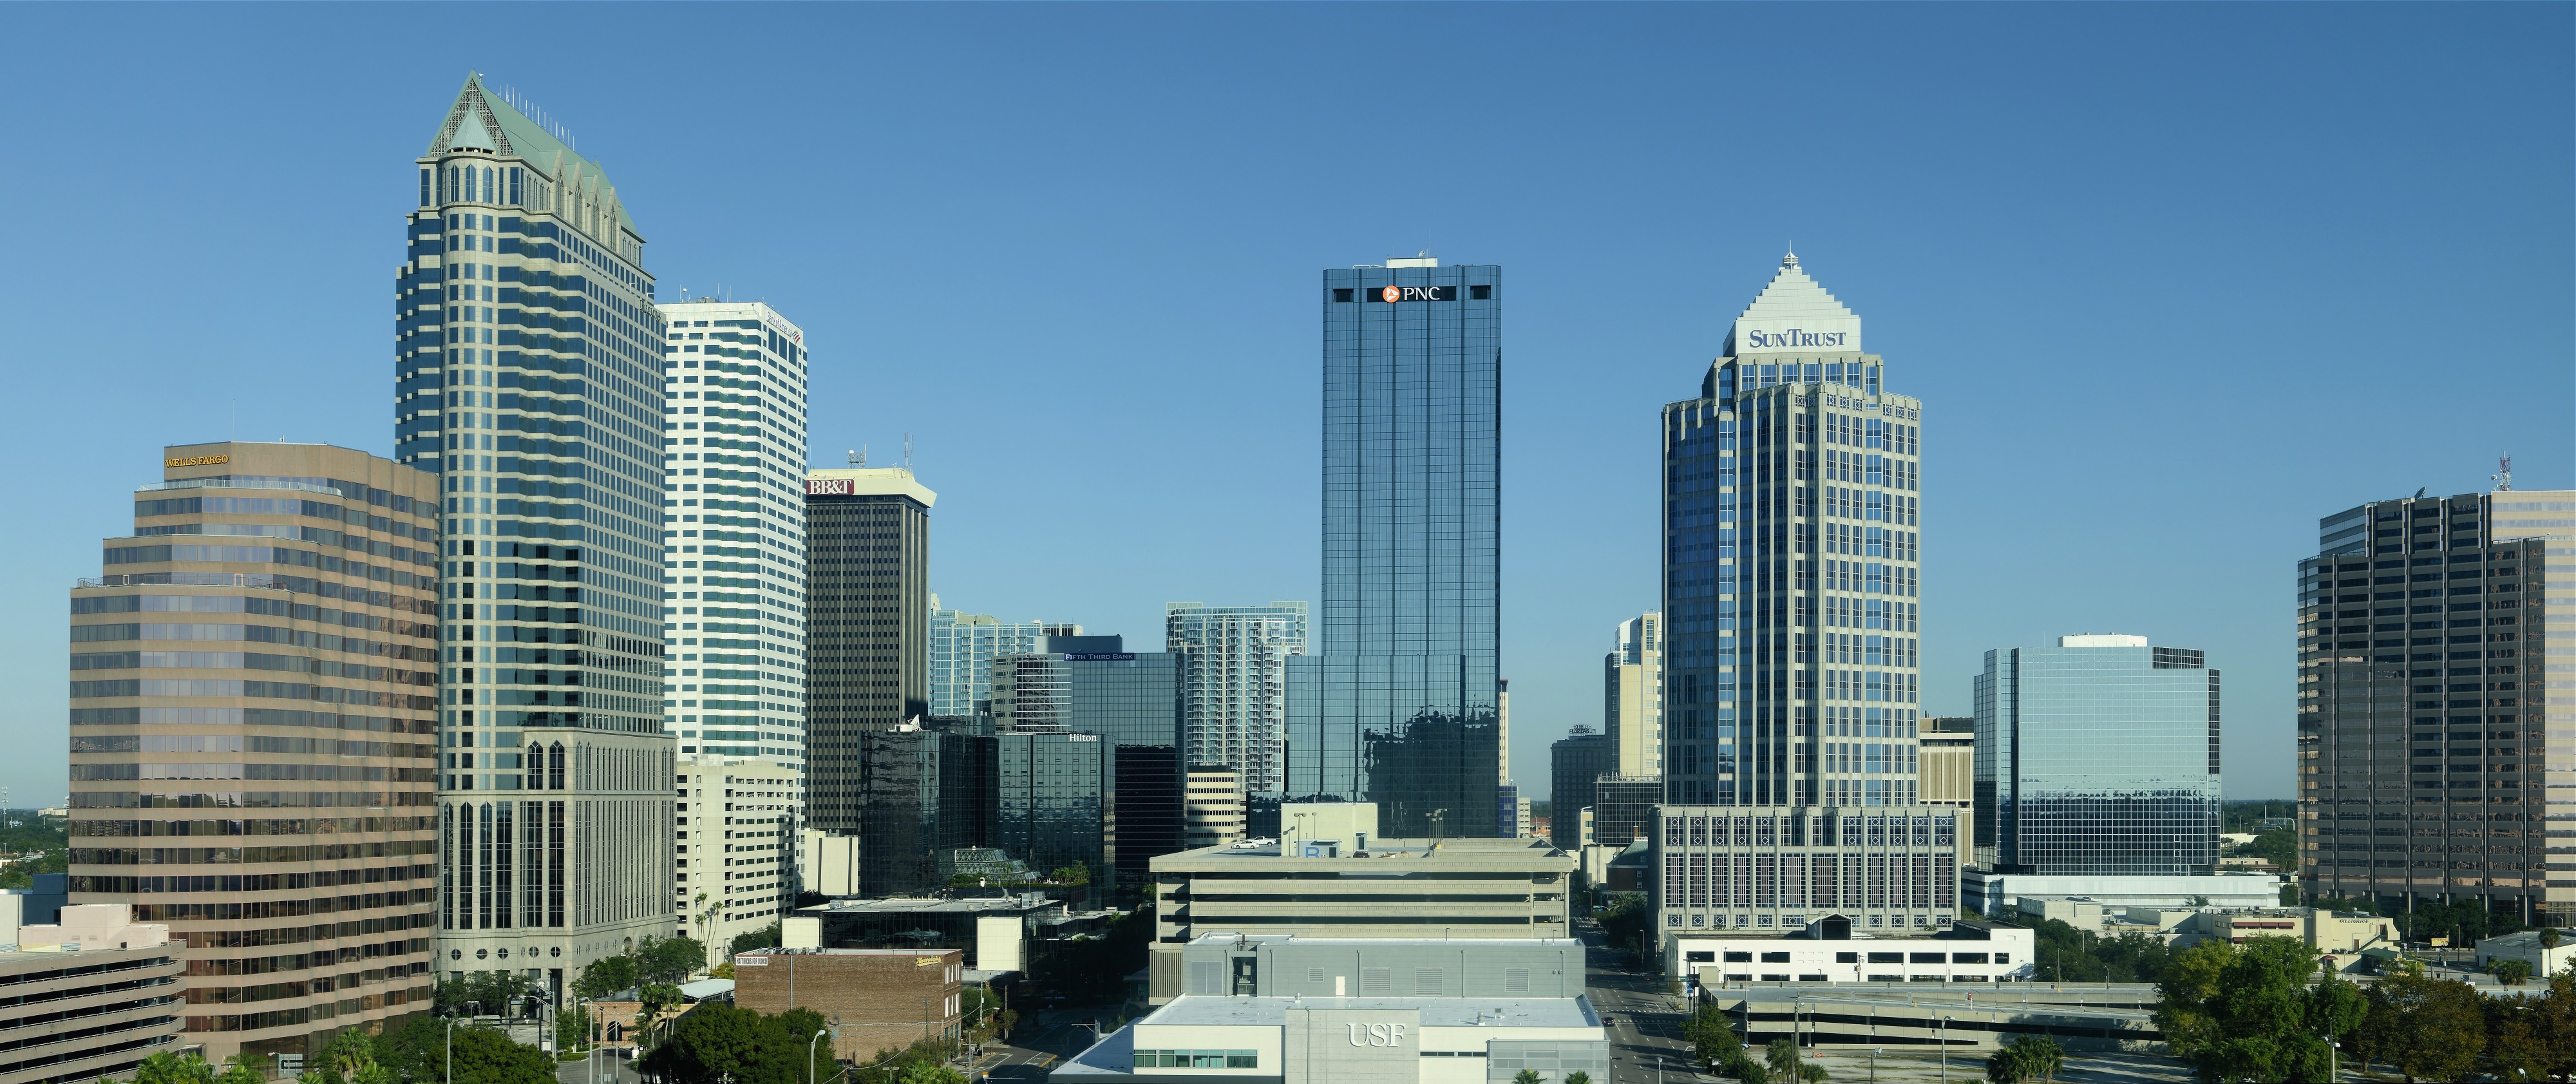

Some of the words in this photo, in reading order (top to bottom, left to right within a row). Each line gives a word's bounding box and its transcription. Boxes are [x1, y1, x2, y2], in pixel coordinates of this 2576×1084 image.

[1402, 287, 1440, 301] PNC
[766, 310, 775, 325] Bank
[165, 457, 196, 468] WELLS
[197, 455, 229, 465] FARGO
[808, 479, 851, 495] BB&T
[1069, 733, 1097, 742] Hilton
[1346, 1023, 1405, 1047] USF
